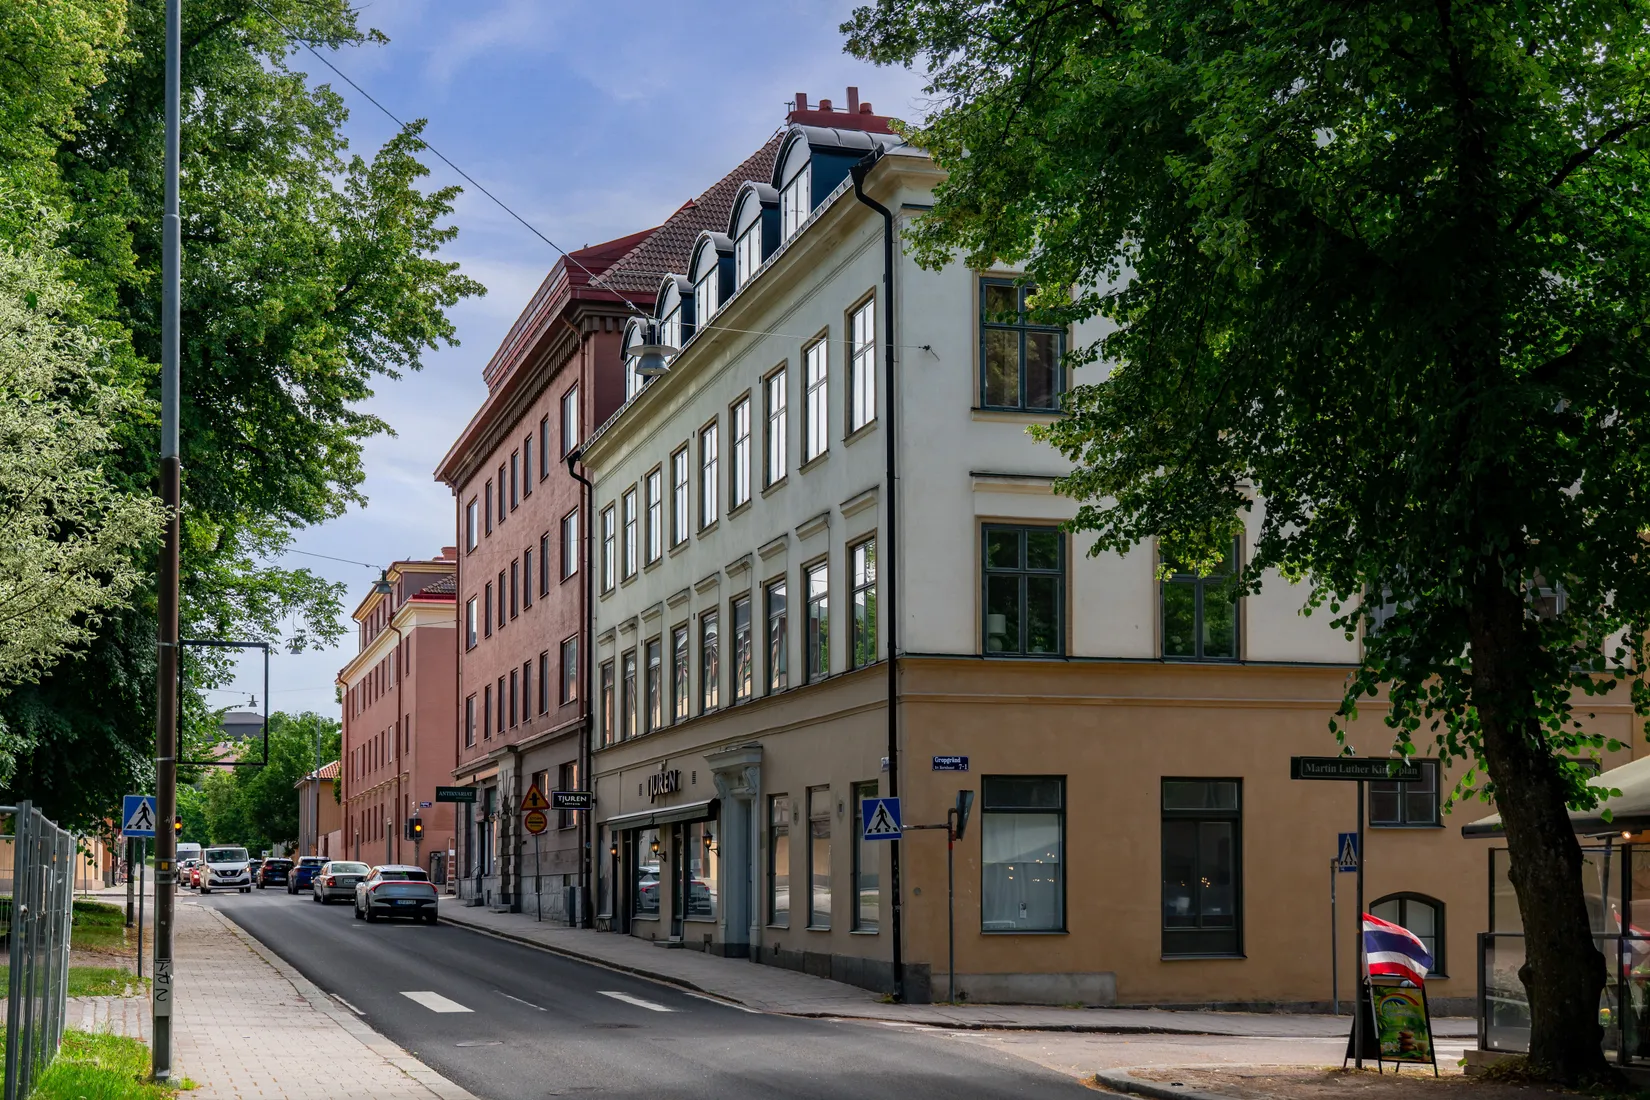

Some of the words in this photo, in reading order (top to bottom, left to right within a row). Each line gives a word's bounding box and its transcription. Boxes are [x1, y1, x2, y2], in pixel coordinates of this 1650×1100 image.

[1305, 763, 1337, 773] Martin
[1339, 764, 1369, 774] Luther
[1371, 764, 1397, 776] Kins
[1398, 765, 1418, 777] plan
[646, 769, 682, 804] TJUREN
[557, 795, 587, 803] TJUREN
